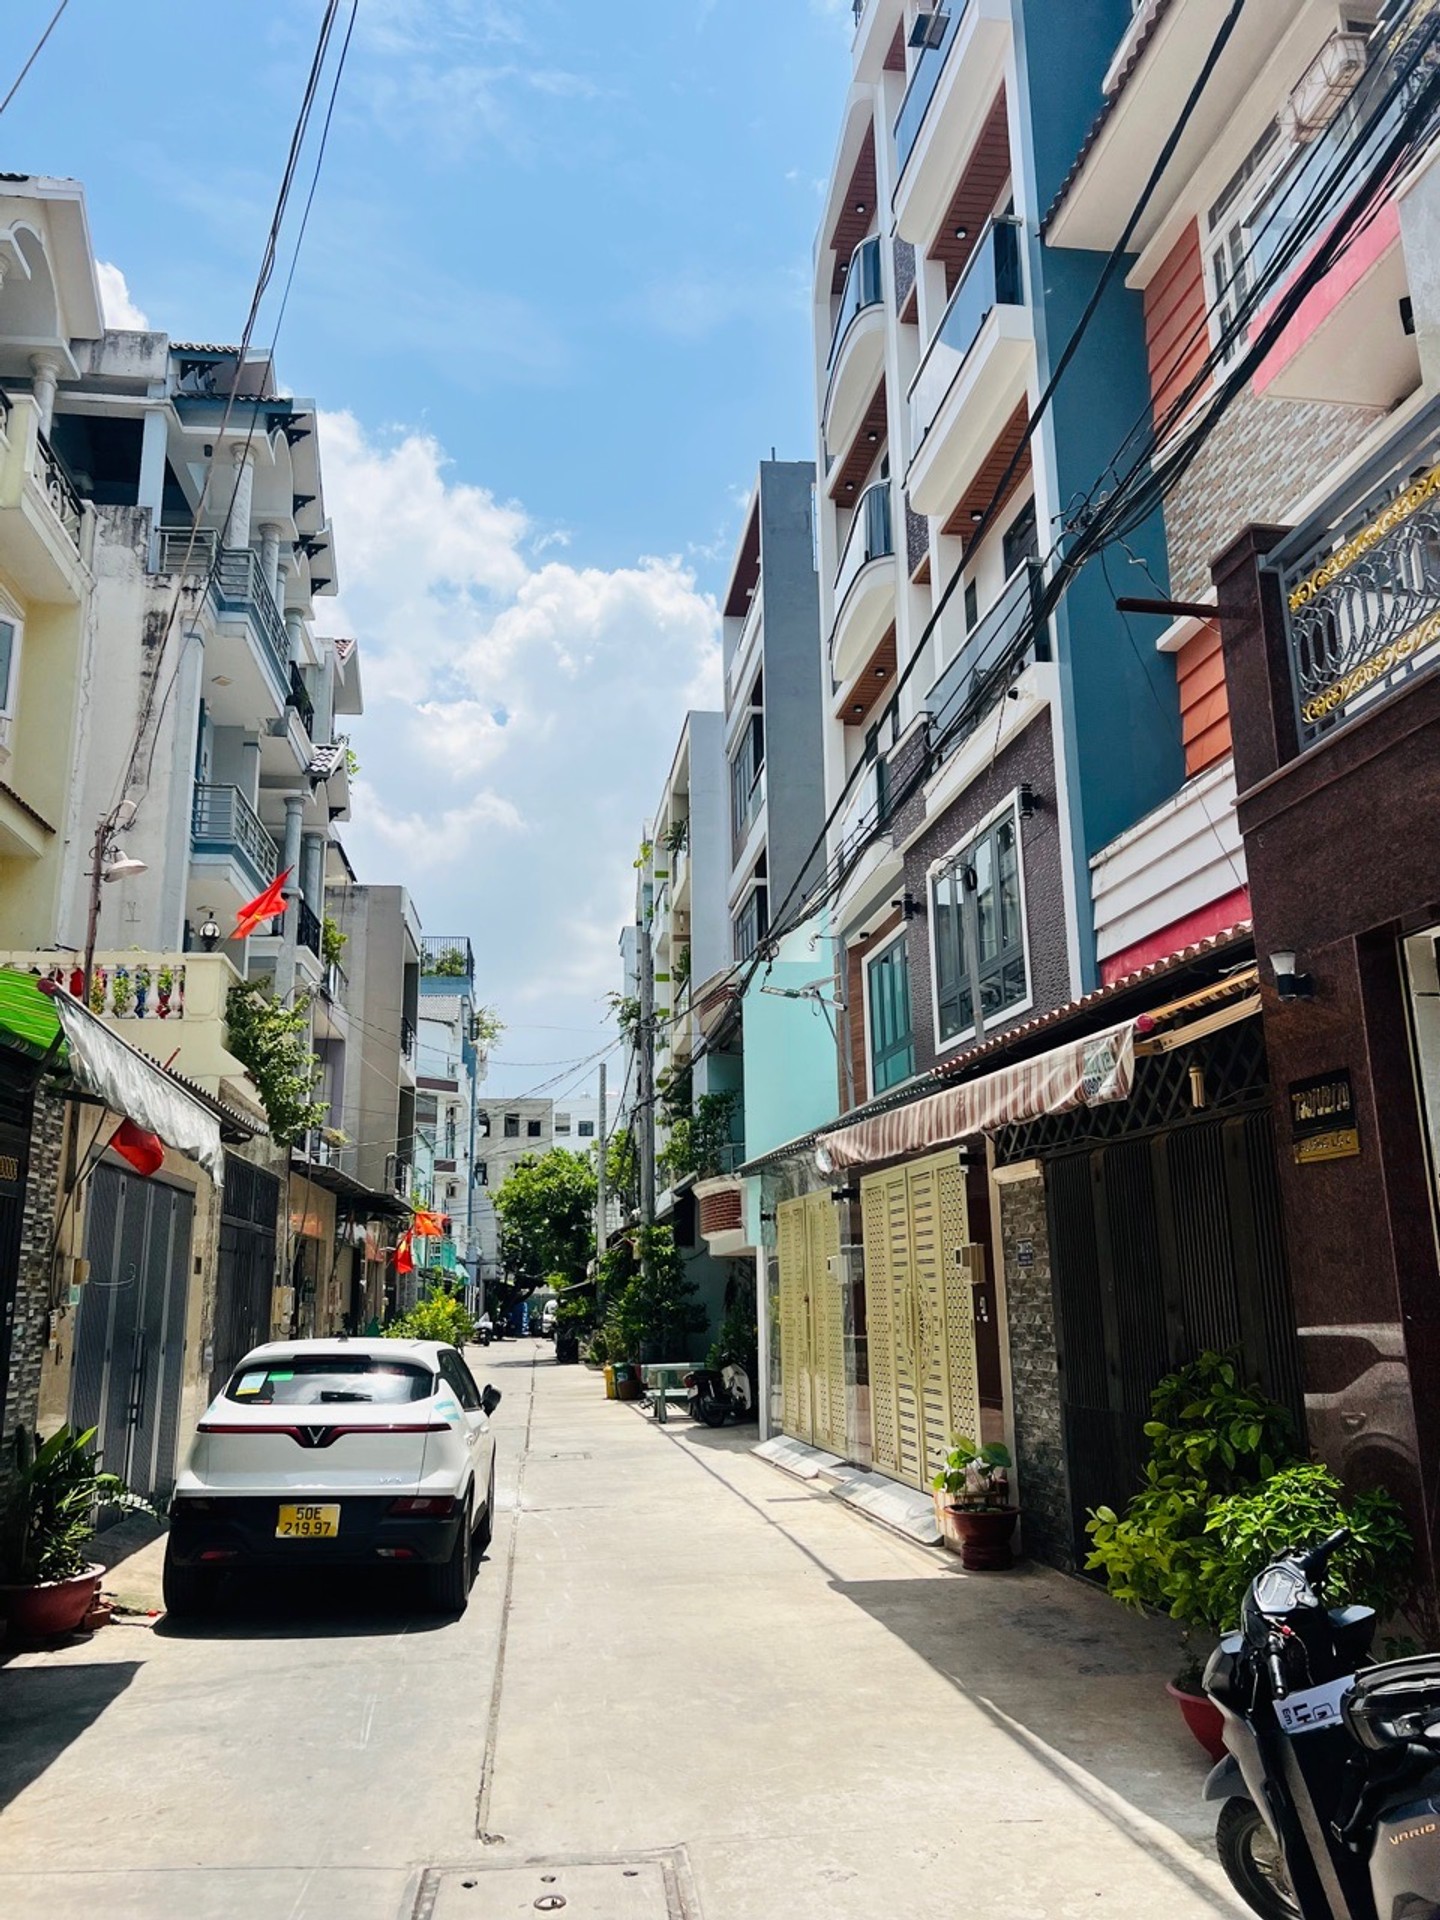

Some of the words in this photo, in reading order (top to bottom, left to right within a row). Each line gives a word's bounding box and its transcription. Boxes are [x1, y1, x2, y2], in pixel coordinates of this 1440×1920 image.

[296, 1506, 322, 1521] 50E
[283, 1521, 332, 1536] 219.97
[1388, 1822, 1436, 1846] VARIO
